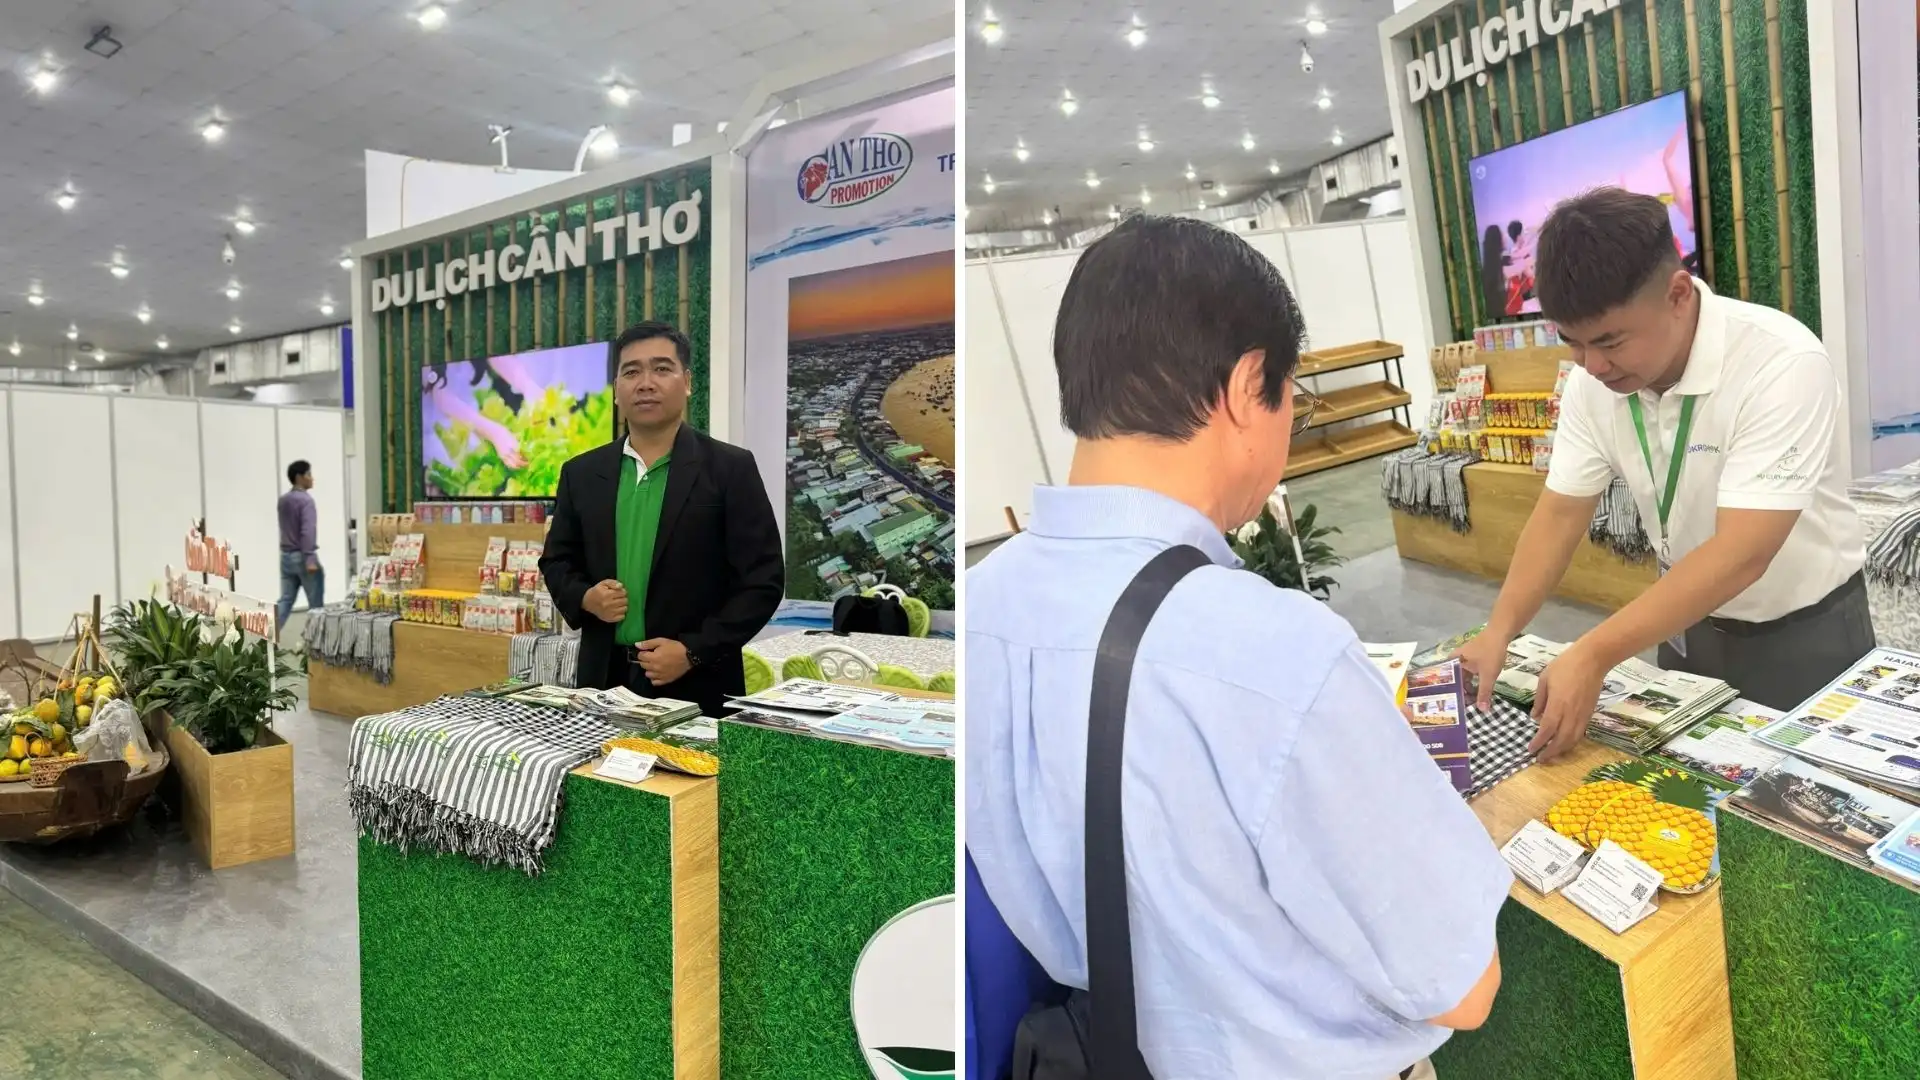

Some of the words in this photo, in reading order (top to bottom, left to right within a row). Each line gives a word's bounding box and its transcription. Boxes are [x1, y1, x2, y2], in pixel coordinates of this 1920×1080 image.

[1405, 43, 1451, 103] DU
[1450, 0, 1540, 87] LỊCH
[830, 174, 895, 205] PROMOTION
[859, 137, 902, 173] THO
[372, 270, 414, 312] DU
[416, 249, 495, 311] LỊCH
[497, 210, 587, 283] CẦN
[593, 189, 703, 261] THƠ
